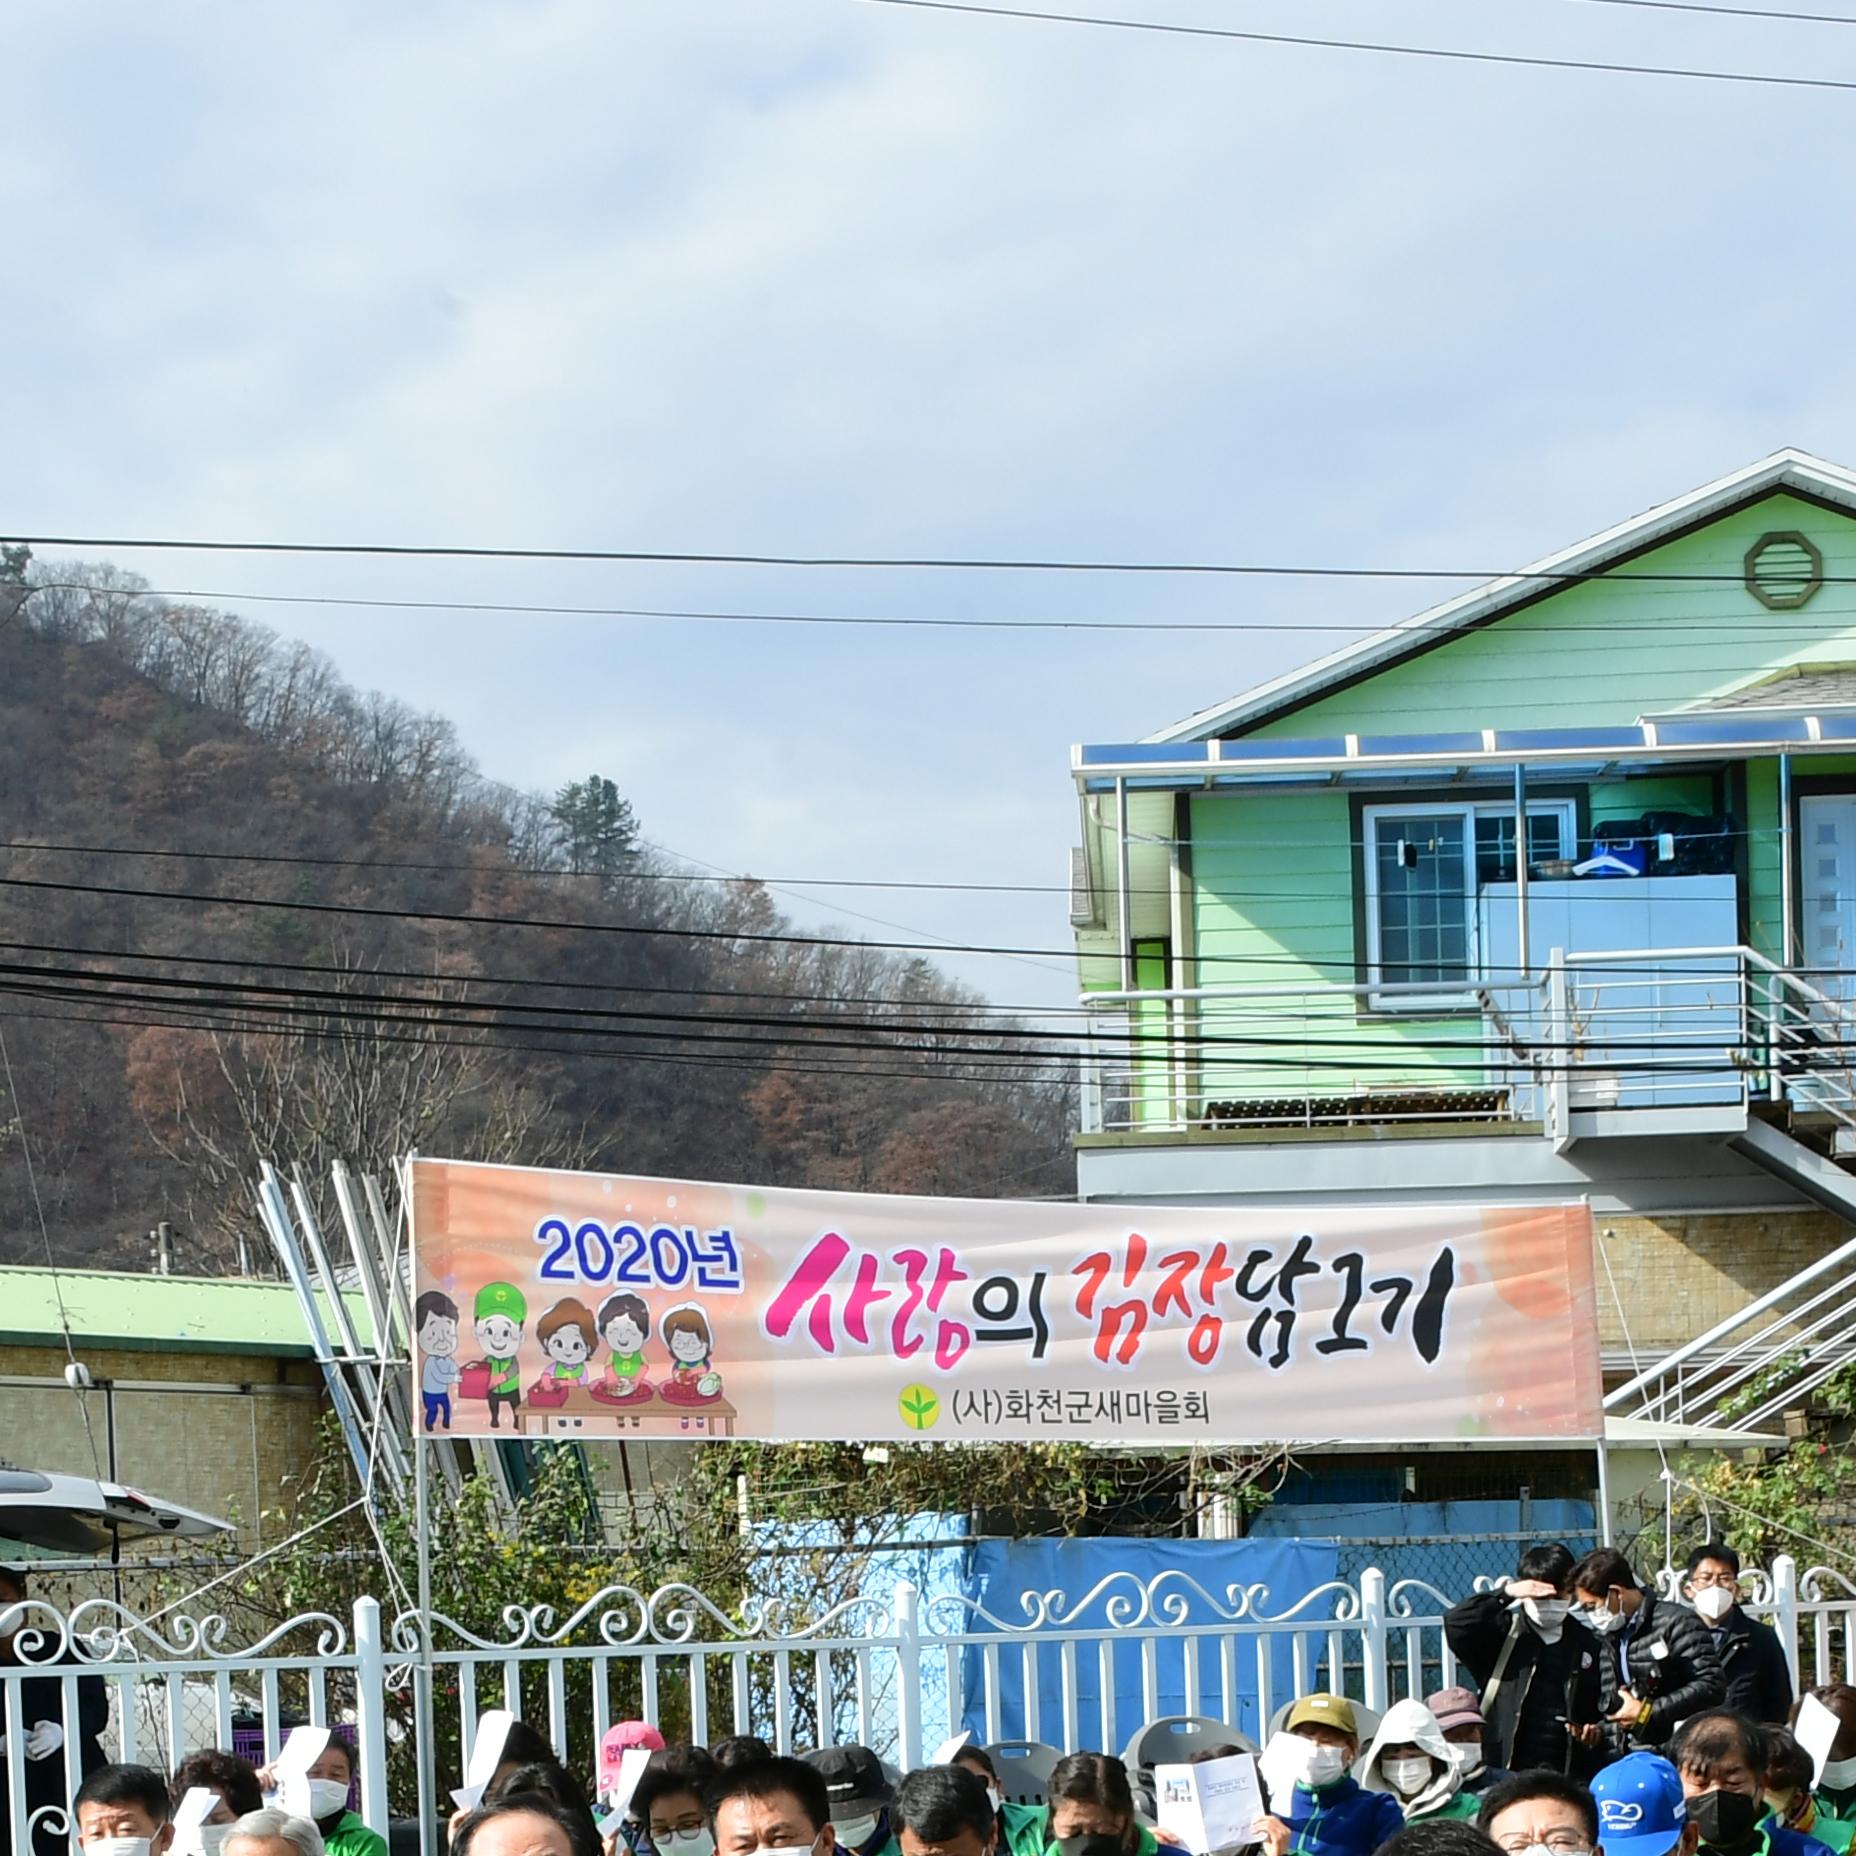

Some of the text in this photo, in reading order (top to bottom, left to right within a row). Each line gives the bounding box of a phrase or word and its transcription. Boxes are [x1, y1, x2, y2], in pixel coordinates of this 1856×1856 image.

[537, 1218, 740, 1289] 2020년
[764, 1232, 1049, 1370] 사랑의
[951, 1388, 1211, 1426] (사)화천군새마을회
